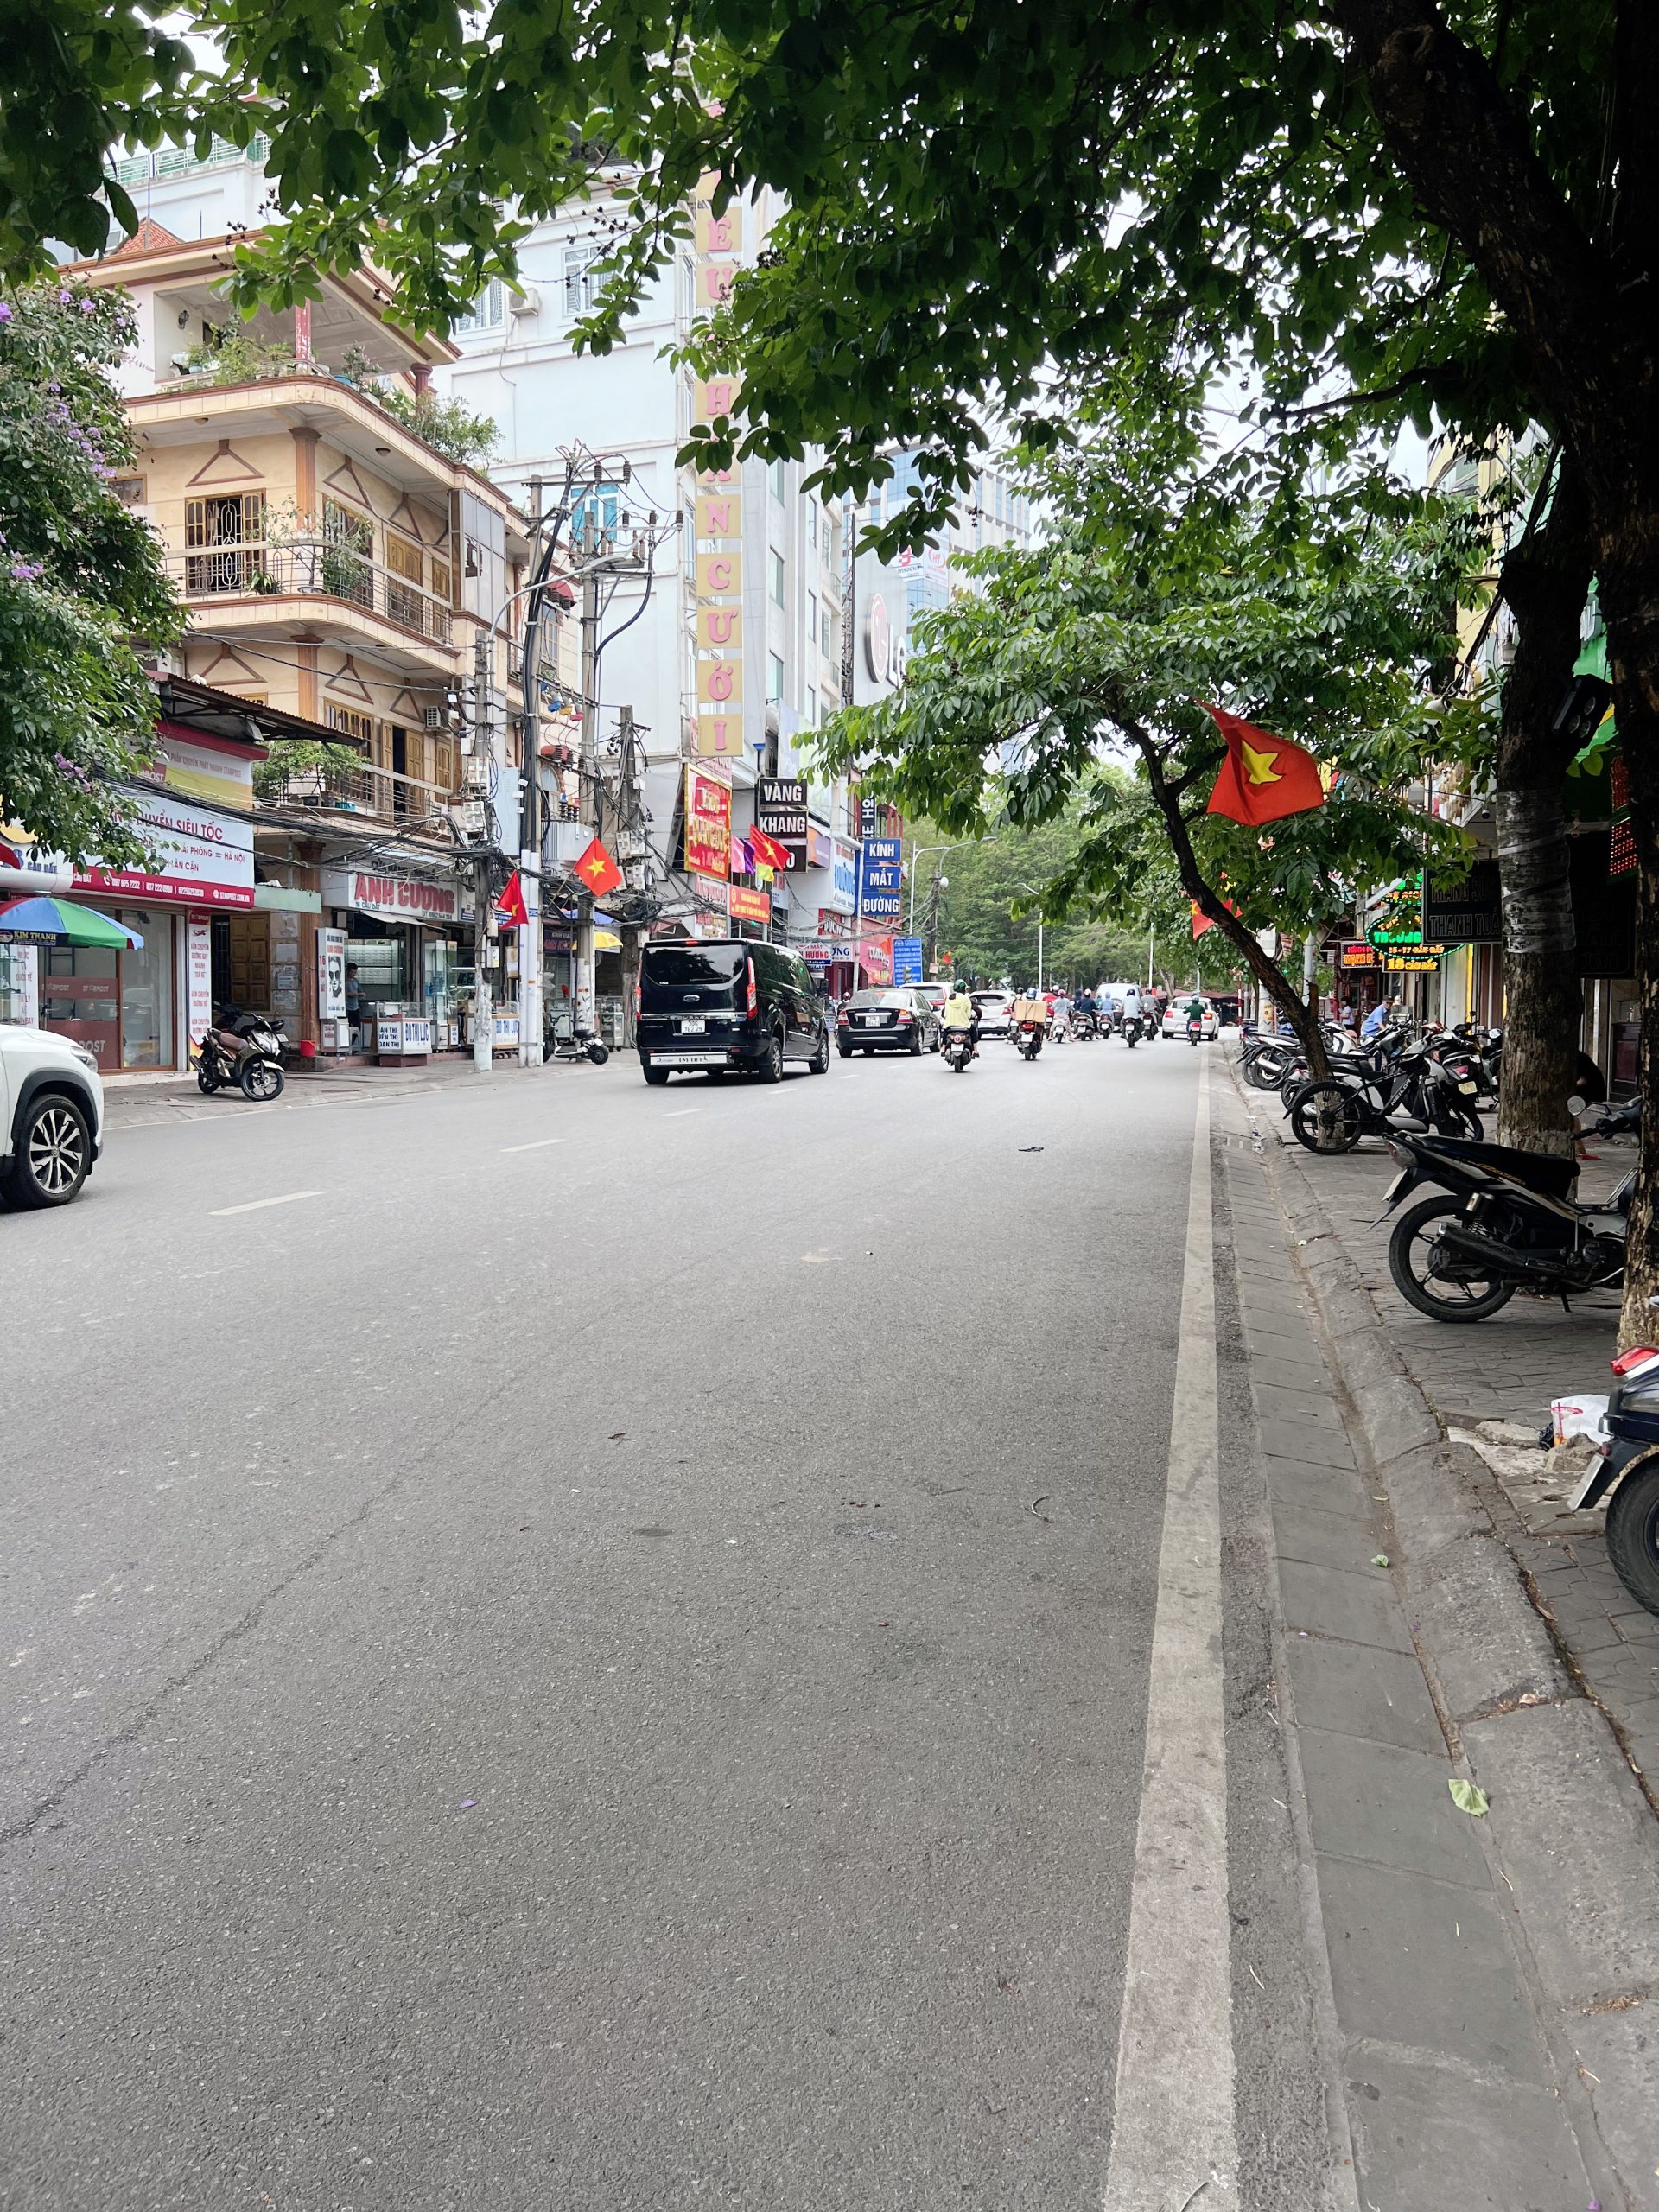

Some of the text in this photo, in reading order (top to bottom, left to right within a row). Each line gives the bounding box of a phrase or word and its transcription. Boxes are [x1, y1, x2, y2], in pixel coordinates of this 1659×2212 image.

[764, 781, 802, 802] VÀNG
[201, 821, 223, 841] TỐC
[760, 817, 806, 833] KHANG
[190, 847, 213, 857] PHÒNG
[869, 841, 895, 857] KÍNH
[869, 868, 893, 886] MẮT
[354, 873, 395, 906] ANH
[863, 896, 899, 912] ĐƯỜNG
[14, 931, 29, 939] KIM
